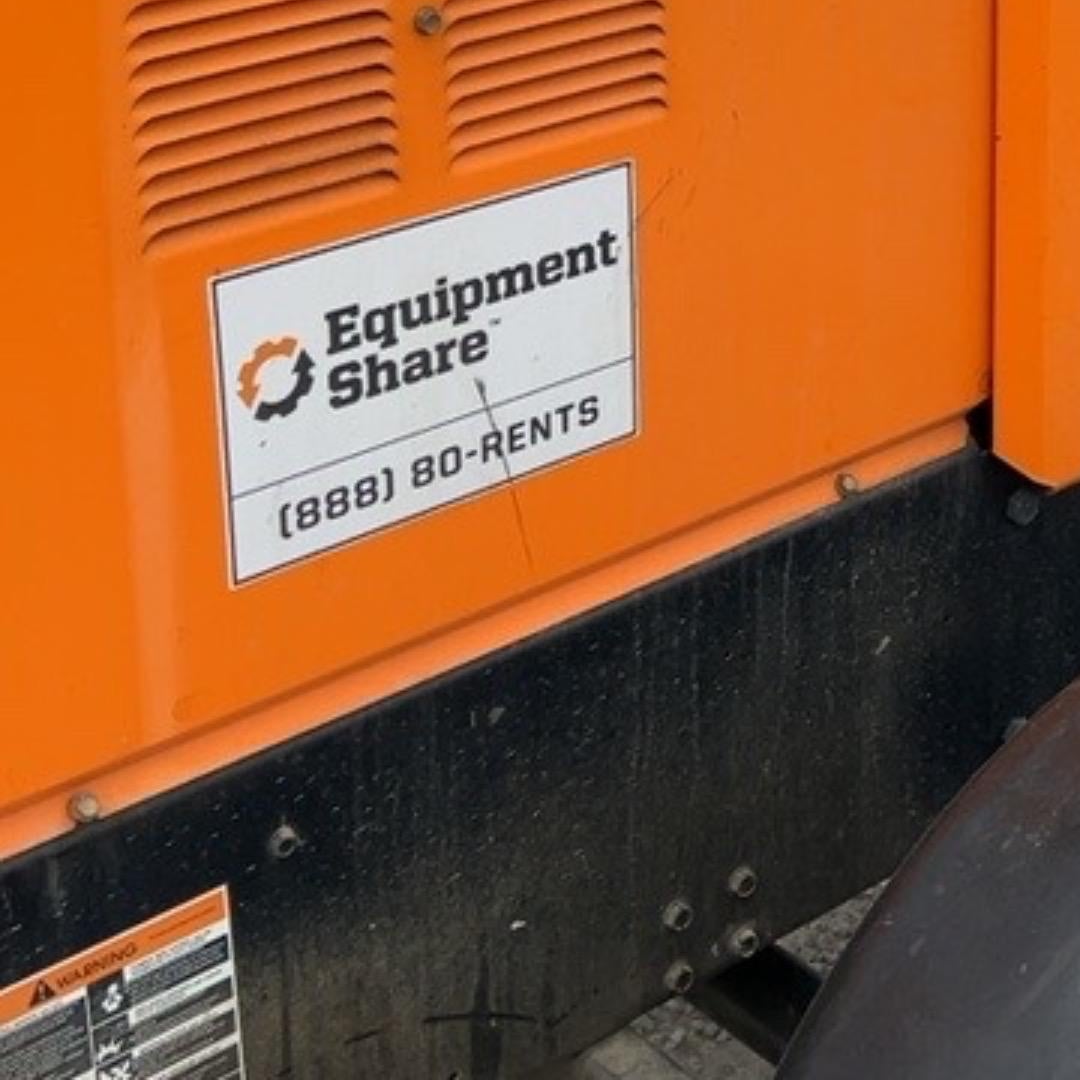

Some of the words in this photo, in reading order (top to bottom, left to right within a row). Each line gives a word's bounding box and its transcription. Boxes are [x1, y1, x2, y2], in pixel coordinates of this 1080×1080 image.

[324, 229, 617, 354] Equipment
[328, 326, 489, 410] Share
[278, 467, 396, 539] (888)
[411, 395, 600, 492] 80-RENTS
